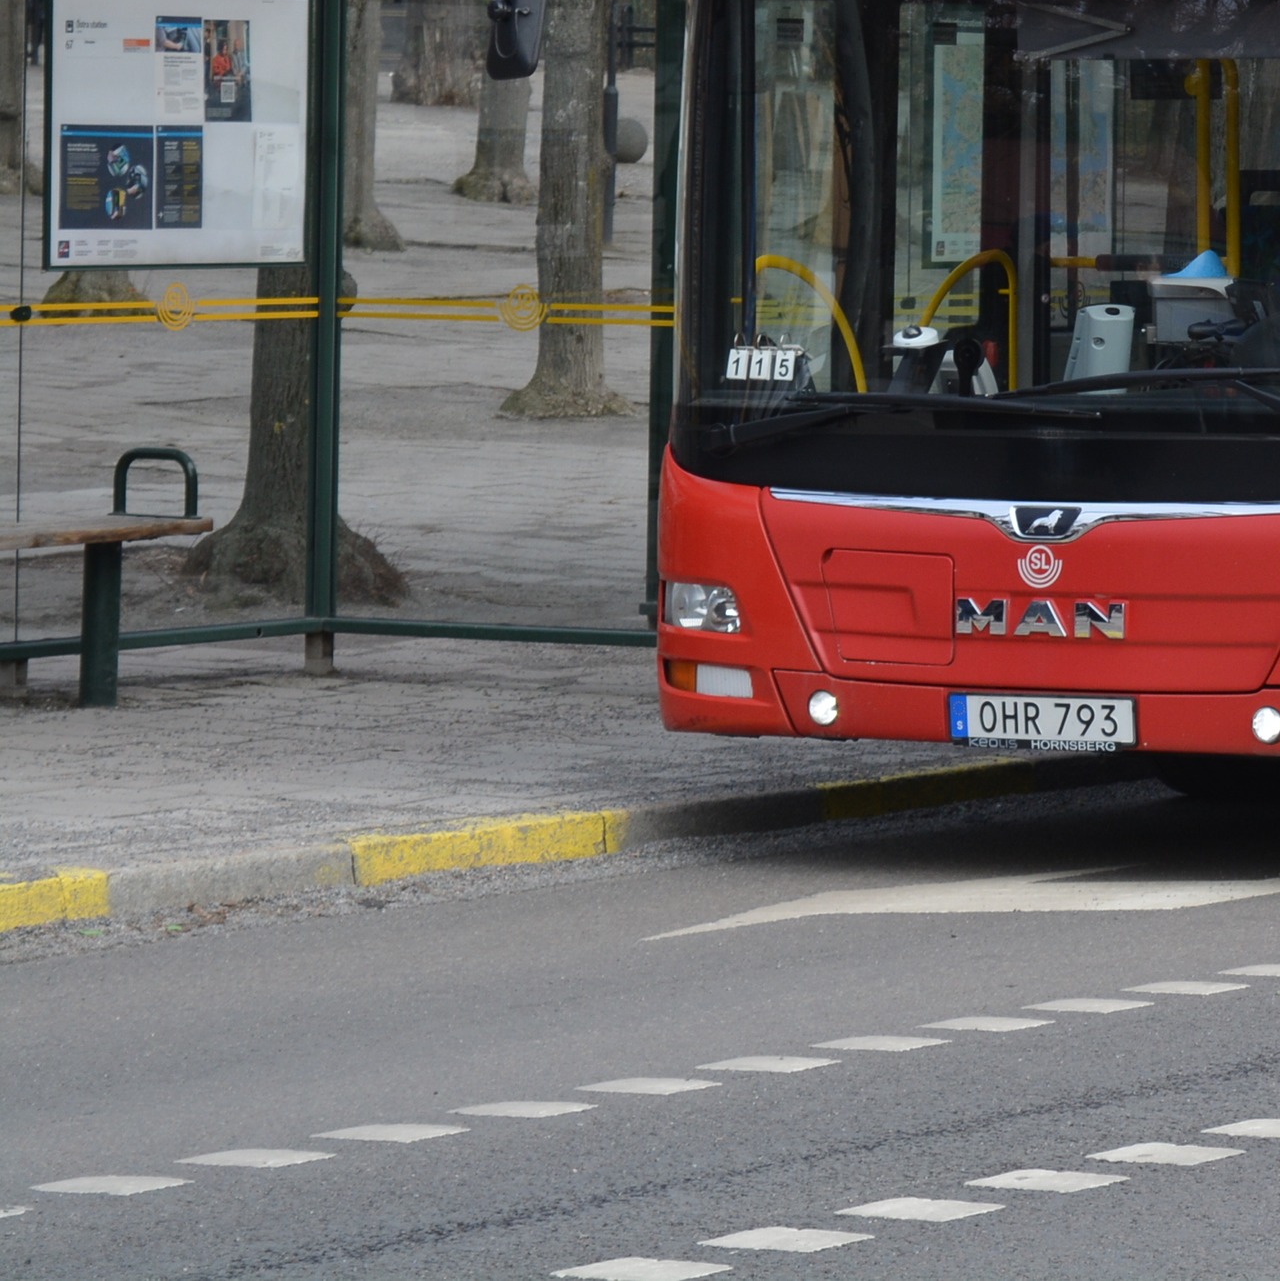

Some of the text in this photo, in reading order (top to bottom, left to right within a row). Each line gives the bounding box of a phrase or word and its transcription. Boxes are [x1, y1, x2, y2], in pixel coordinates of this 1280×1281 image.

[1030, 552, 1050, 570] SL
[955, 596, 1129, 640] MAN
[956, 700, 1119, 738] S OHR 793
[1030, 739, 1117, 752] HORNSBERG
